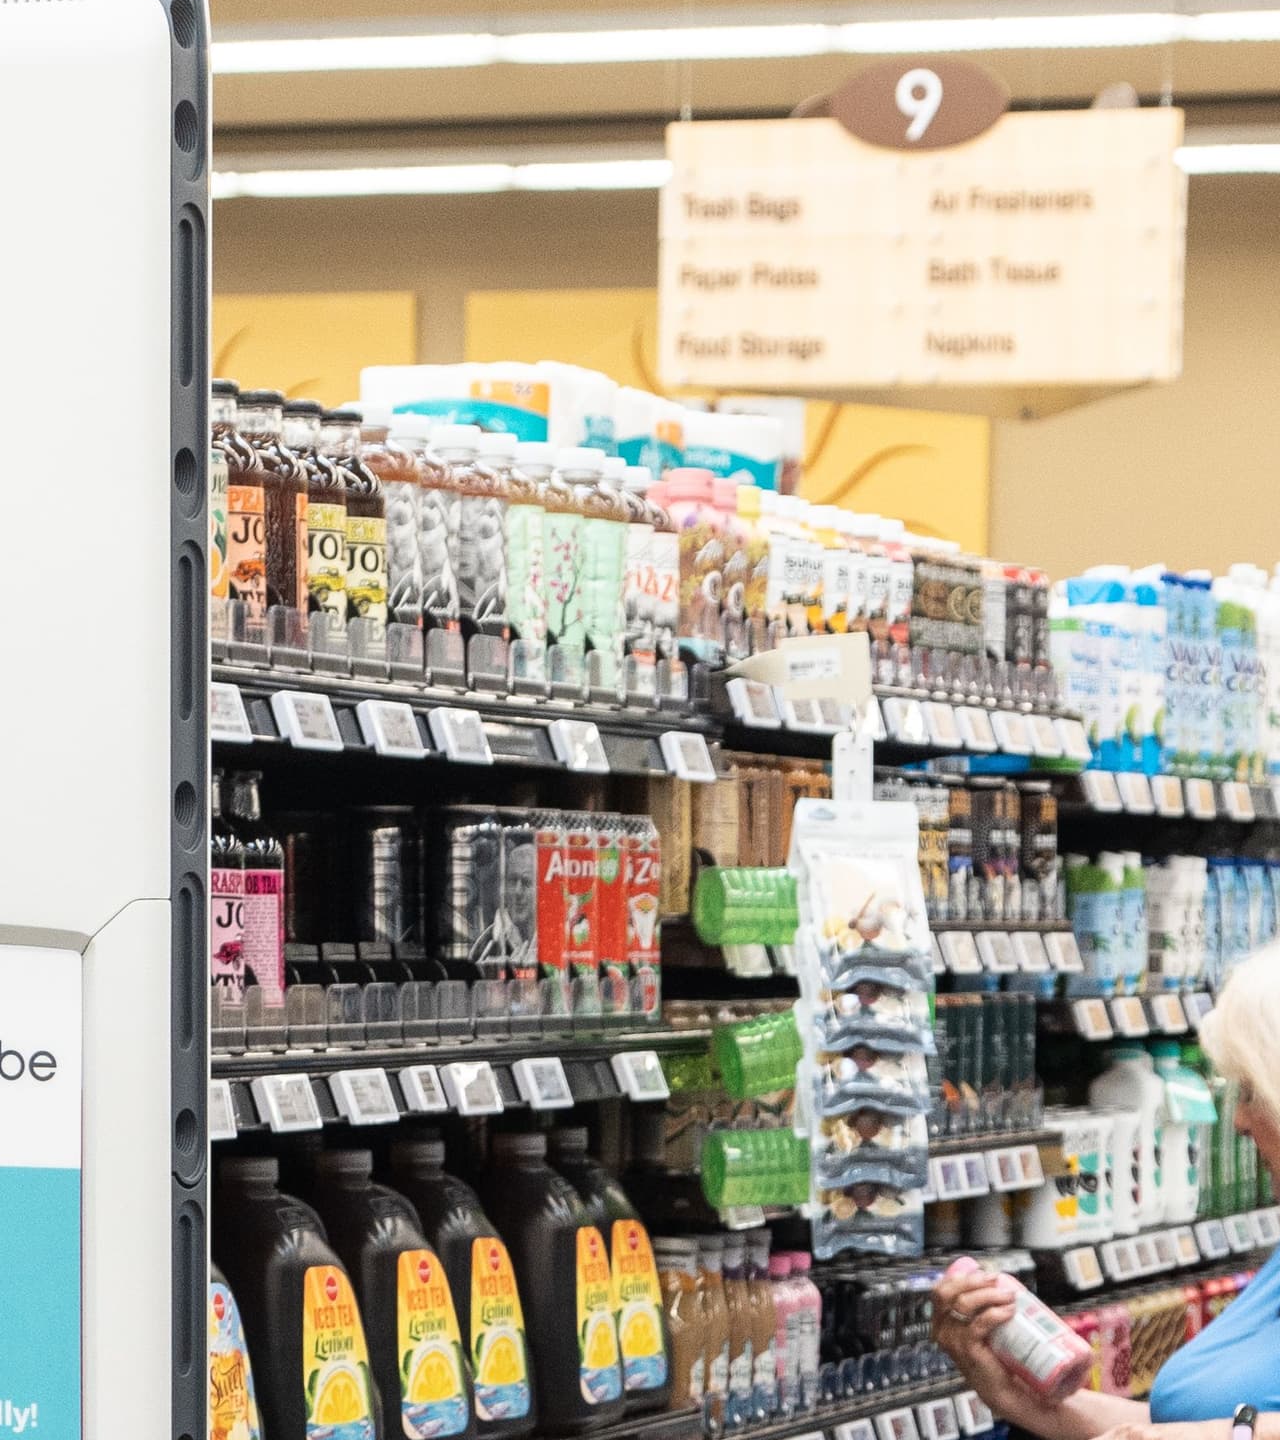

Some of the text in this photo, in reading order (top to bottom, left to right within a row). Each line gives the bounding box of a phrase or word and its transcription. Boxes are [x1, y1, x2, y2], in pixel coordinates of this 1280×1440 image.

[893, 67, 944, 142] 9
[313, 1306, 334, 1330] ICED
[409, 1313, 447, 1341] Lemon
[315, 1330, 354, 1361] Lemon
